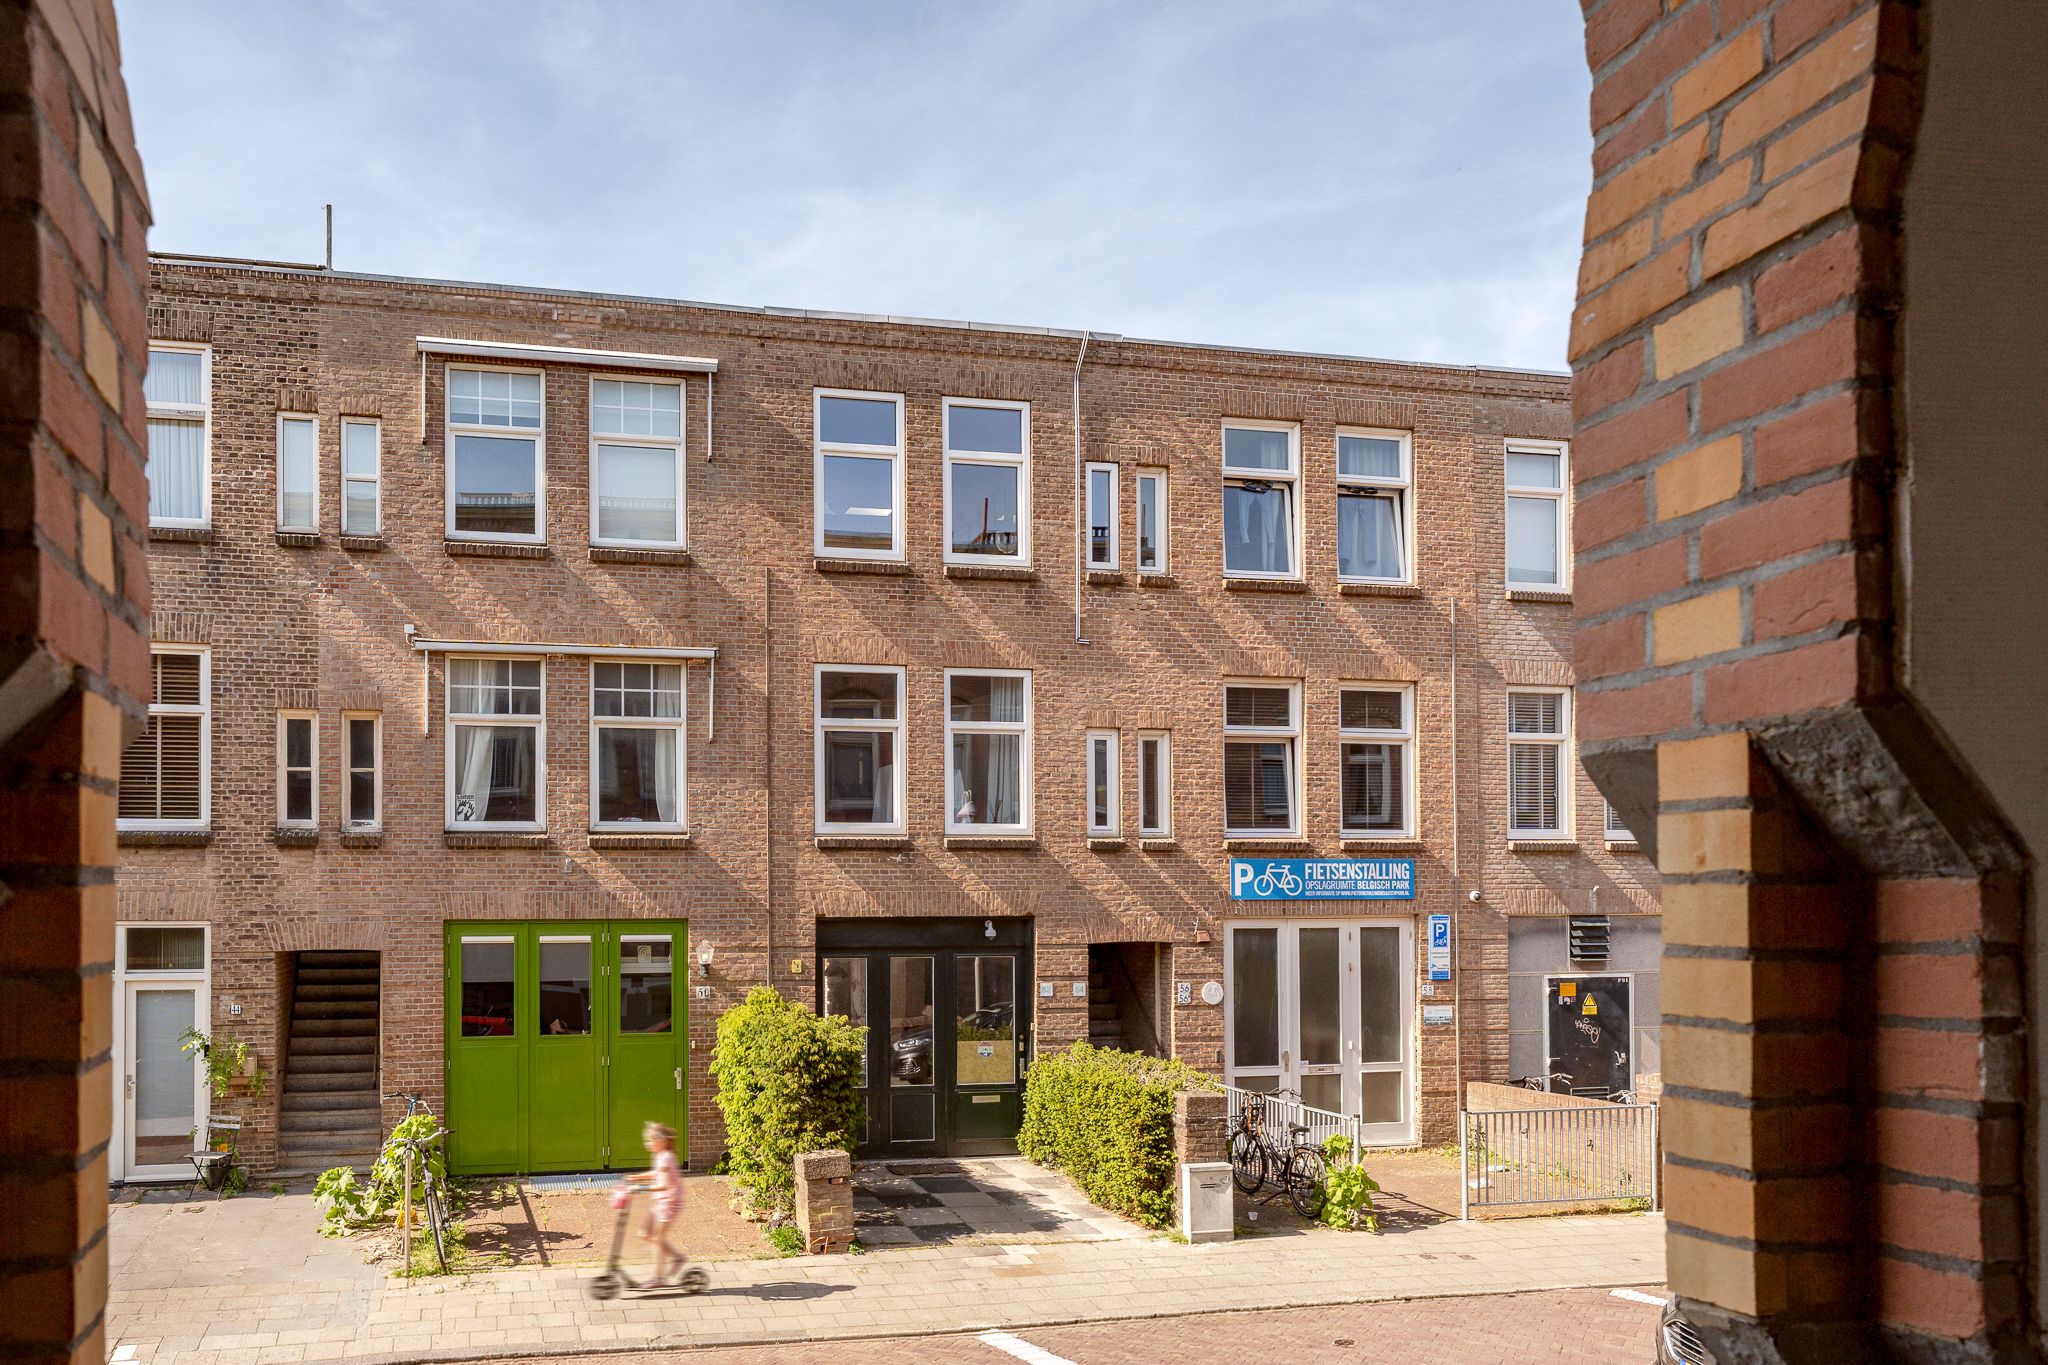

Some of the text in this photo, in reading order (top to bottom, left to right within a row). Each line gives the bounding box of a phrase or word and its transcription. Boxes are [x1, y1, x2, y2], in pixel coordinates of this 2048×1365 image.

[1304, 862, 1410, 880] FIETSENSTALLING
[1234, 863, 1254, 896] P
[1305, 880, 1410, 890] OPSLAGRUIMTE BELGISCH PARK
[1436, 924, 1444, 938] P
[1180, 984, 1190, 993] 56
[1423, 986, 1433, 995] 58
[231, 1005, 240, 1014] 44
